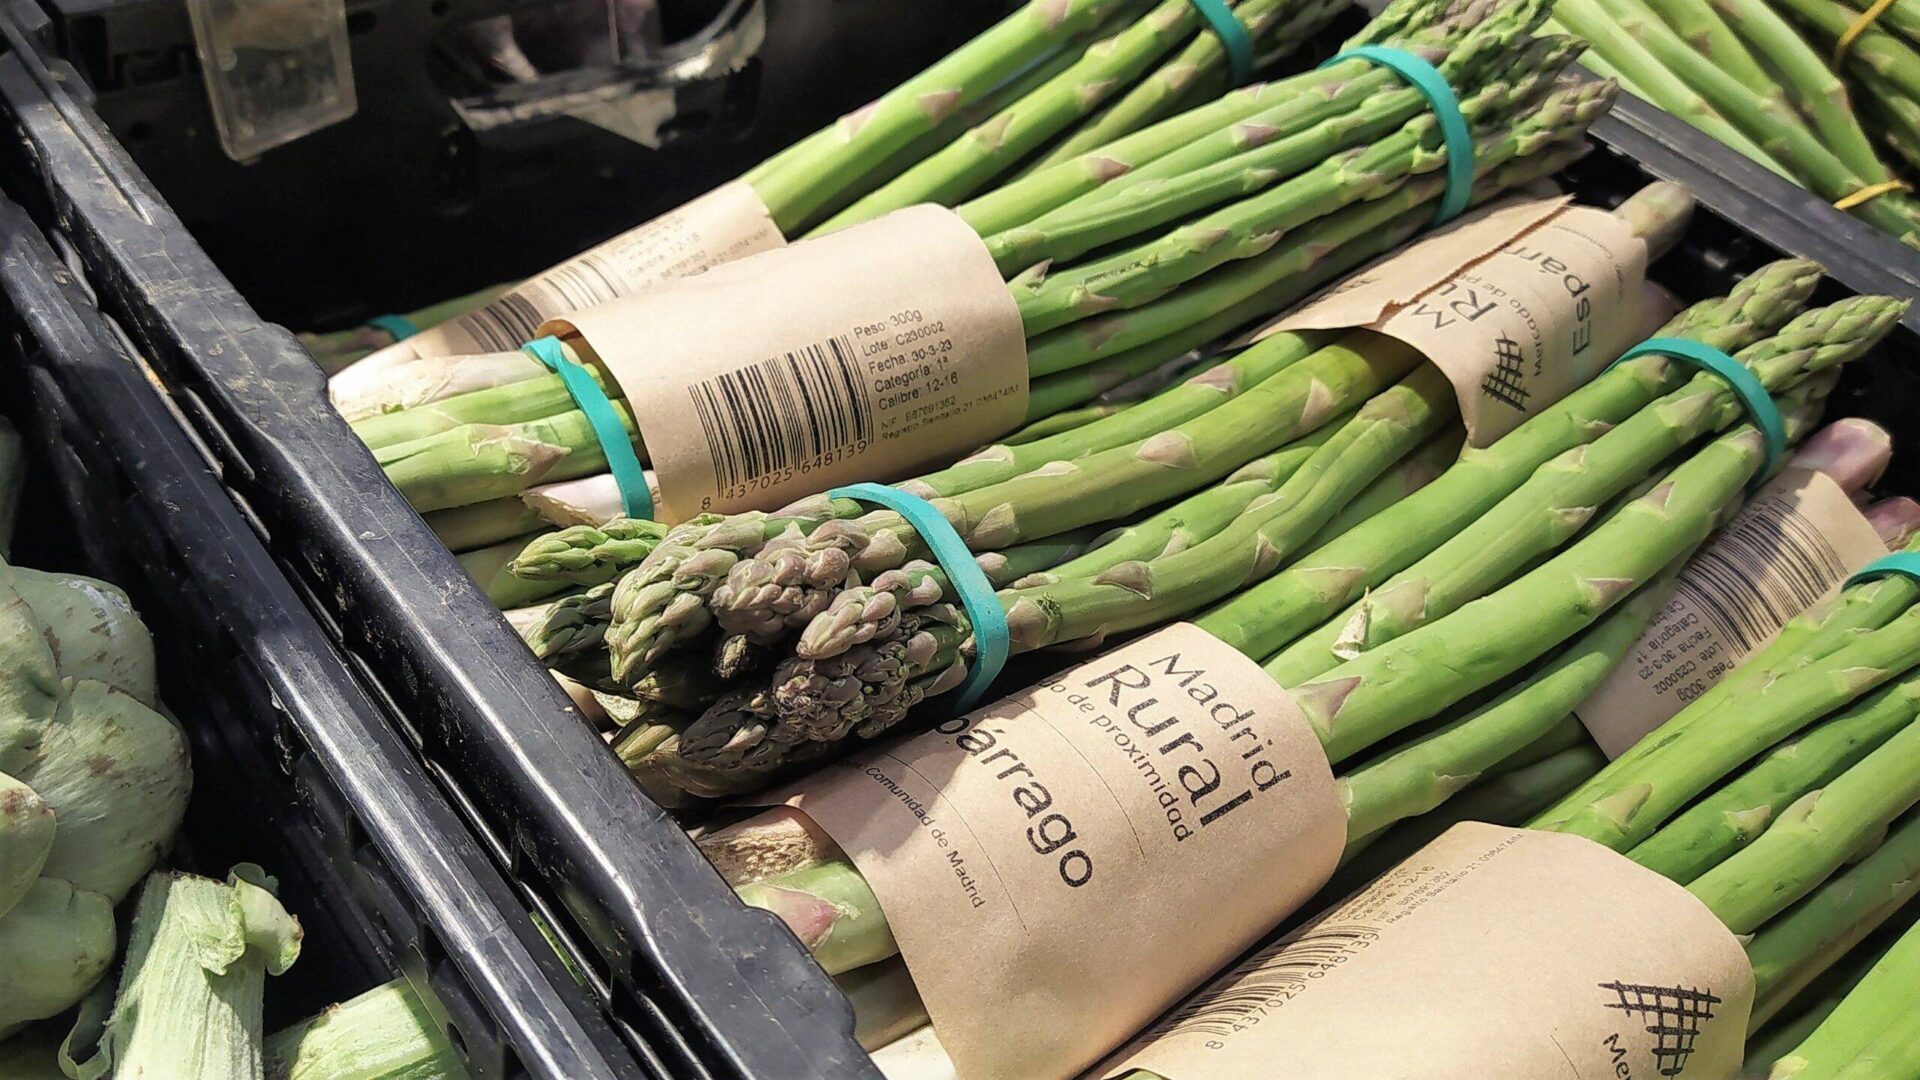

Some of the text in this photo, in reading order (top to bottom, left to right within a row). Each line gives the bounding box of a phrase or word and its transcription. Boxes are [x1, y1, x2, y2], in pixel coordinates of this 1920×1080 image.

[1482, 282, 1507, 298] de
[853, 310, 923, 339] Peso: 300g
[861, 321, 945, 357] Lote: C230002
[868, 339, 953, 376] Fecha: 30-3-23
[878, 371, 959, 411] Calibre: 12-16
[701, 440, 867, 510] 8 437025 648139
[1678, 626, 1712, 654] Fecha:
[1652, 660, 1697, 695] C230002
[1676, 678, 1706, 701] 300g
[1148, 652, 1292, 792] Madrid
[1084, 663, 1255, 829] Rural
[1067, 693, 1095, 713] de
[1090, 715, 1194, 843] proximidad
[865, 767, 987, 910] Comunidad de Madrid
[1205, 932, 1381, 1050] 8 437025 648139
